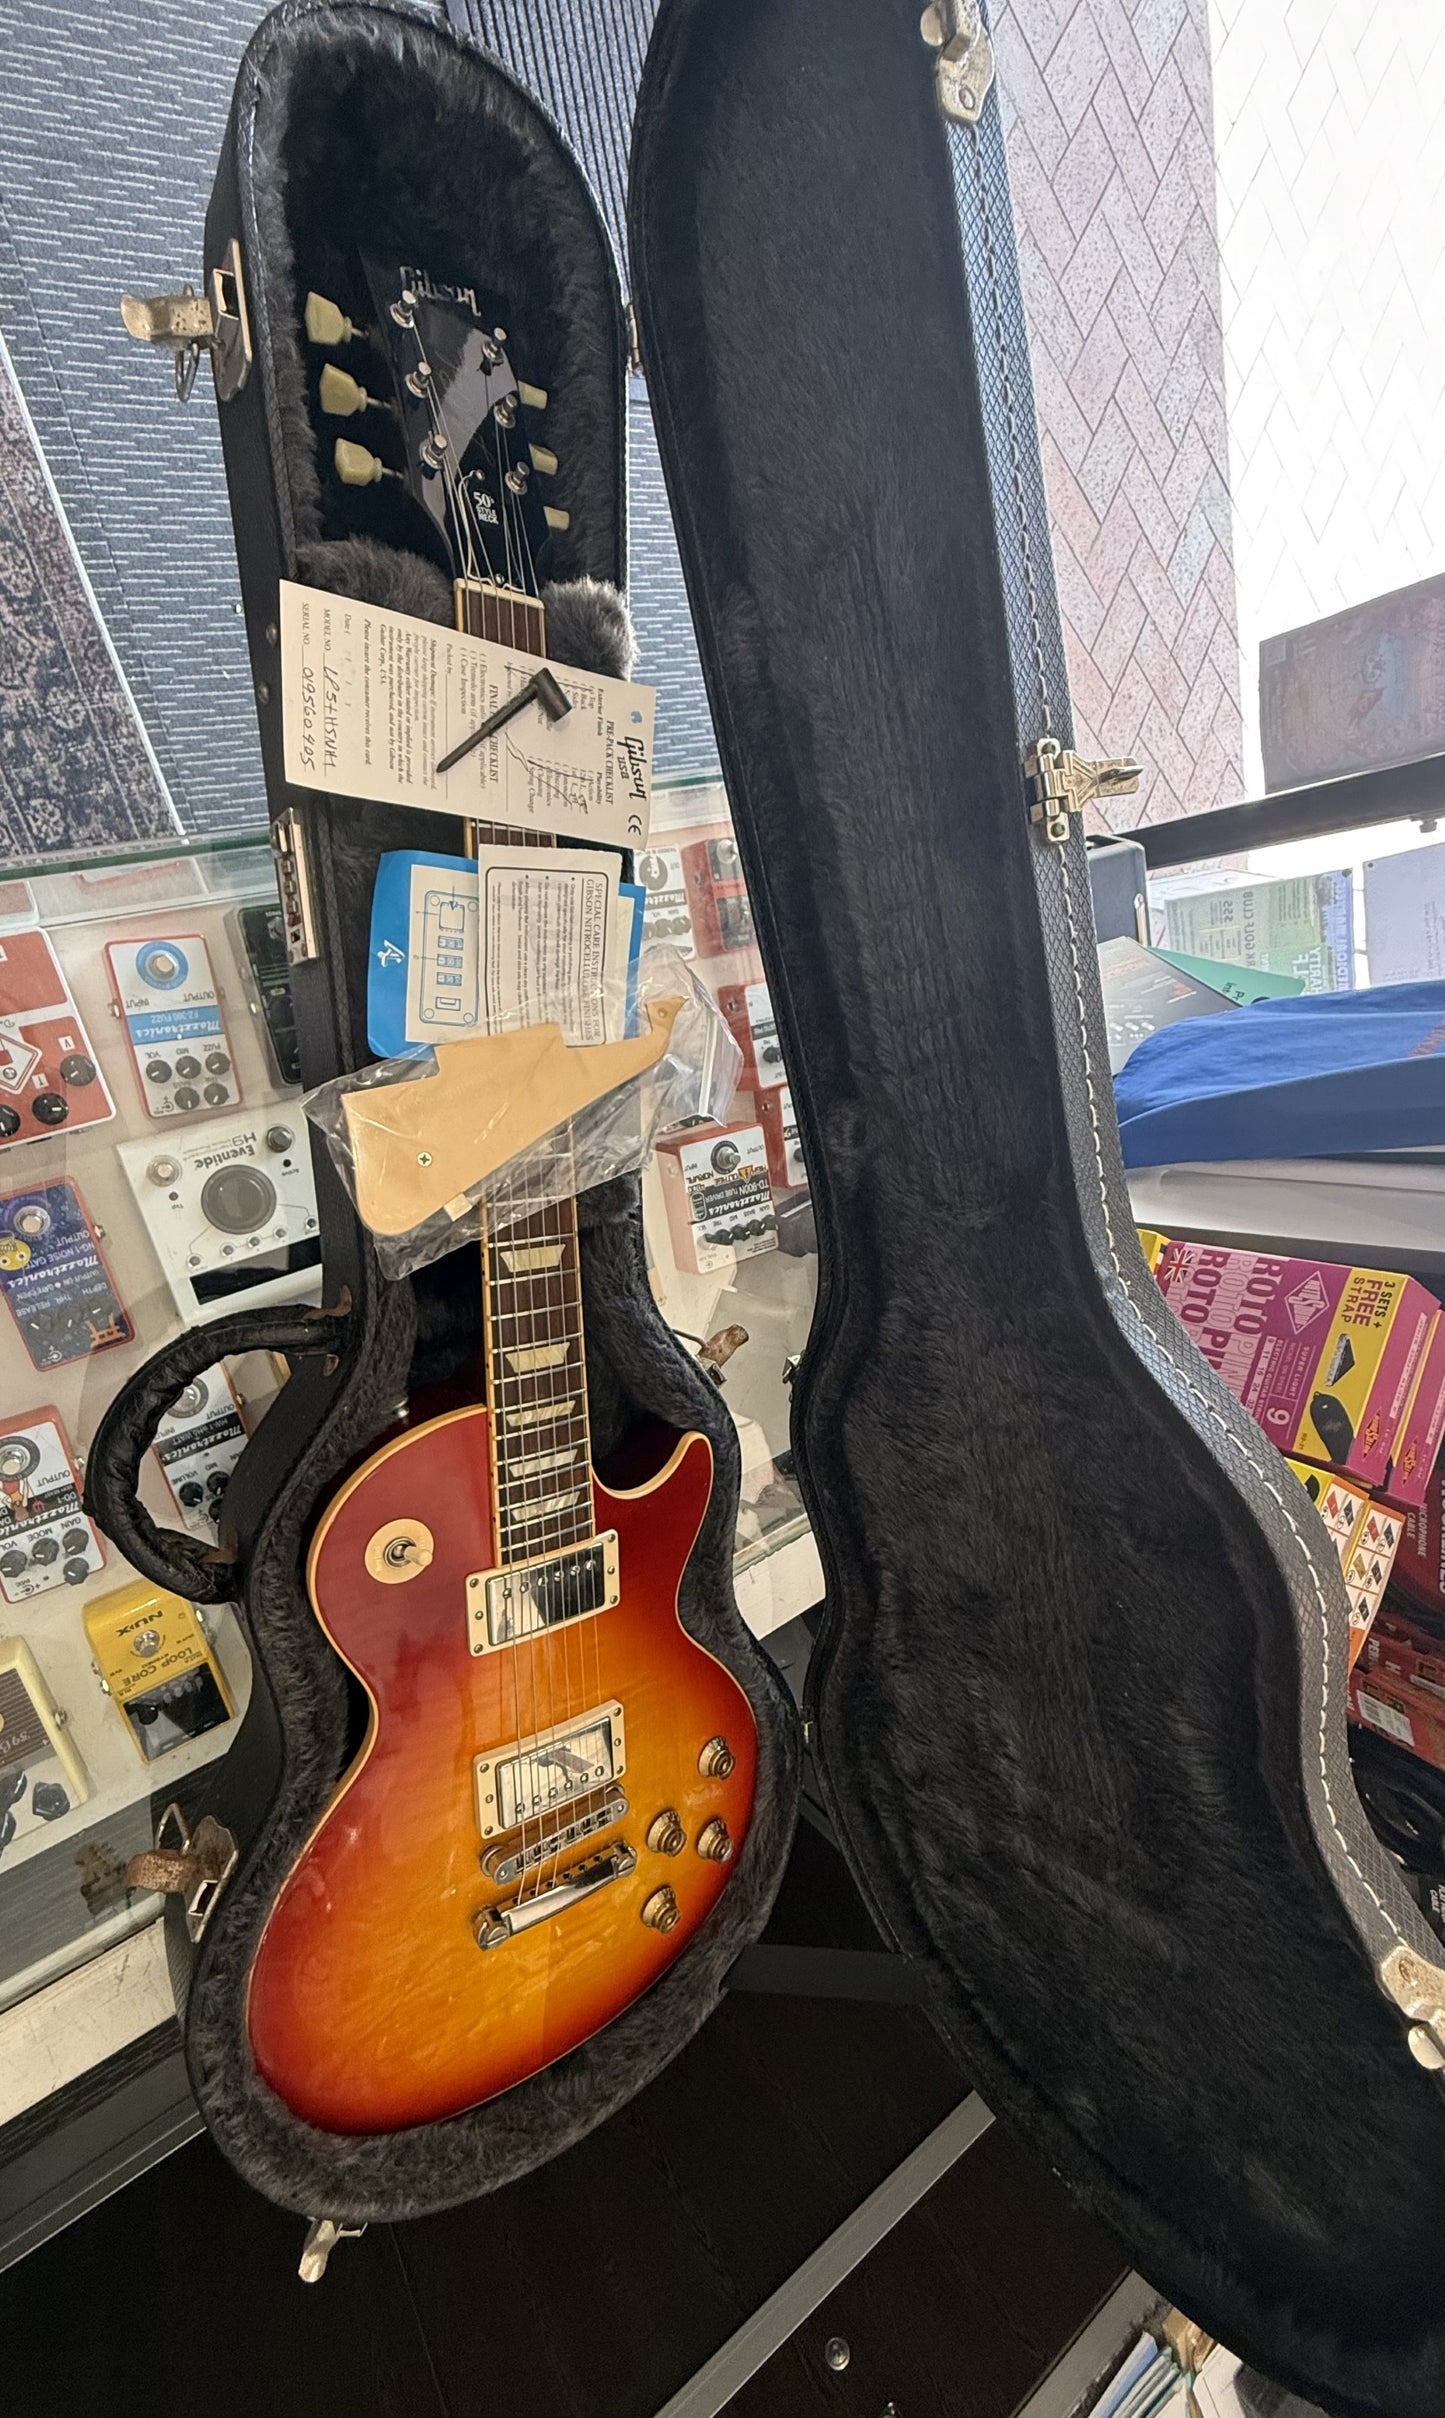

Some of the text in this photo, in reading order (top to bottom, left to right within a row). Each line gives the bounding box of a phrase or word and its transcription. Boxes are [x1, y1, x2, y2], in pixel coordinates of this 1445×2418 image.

[323, 608, 331, 635] MODEL
[459, 658, 468, 714] Case Inspection
[489, 684, 498, 782] FINAL CHECKLIST
[605, 720, 614, 804] PRE-PACK CHECKLIST
[616, 736, 647, 800] Gibson
[627, 814, 641, 835] CE
[585, 879, 593, 914] GIBSON
[593, 883, 602, 921] SPECIAL
[592, 924, 600, 948] CARE
[582, 917, 591, 998] NITROCELLULOSE
[124, 998, 148, 1008] INPUT
[182, 991, 214, 1001] OUTPUT
[145, 1050, 160, 1059] VOL
[175, 1046, 189, 1055] MID
[203, 1042, 220, 1051] FUZZ
[231, 1132, 256, 1147] H9
[193, 1144, 254, 1170] Eventide
[683, 1163, 697, 1171] INPUT
[704, 1191, 724, 1203] DRIVER
[54, 1229, 89, 1246] OUTPUT
[46, 1247, 73, 1262] NOISE
[81, 1281, 106, 1295] DEPTH
[1180, 1250, 1230, 1321] ROTO
[1207, 1255, 1257, 1327] ROTO
[1234, 1258, 1279, 1333] ROTO
[1341, 1277, 1364, 1322] STRAP
[1352, 1280, 1382, 1326] FREE
[15, 1300, 50, 1316] RELEASE
[1374, 1292, 1392, 1317] SETS
[1262, 1350, 1269, 1359] 11
[1260, 1339, 1282, 1397] ELECTRIC GUITAR
[1289, 1346, 1309, 1396] SUPER LIGHT
[1252, 1383, 1259, 1392] 24
[205, 1403, 234, 1419] OUTPUT
[1266, 1407, 1290, 1424] 9
[204, 1462, 217, 1470] MID
[36, 1469, 70, 1486] OUTPUT
[171, 1469, 198, 1485] VOLUME
[56, 1491, 76, 1504] DD-1
[60, 1516, 81, 1528] GAIN
[26, 1527, 52, 1541] MODE
[121, 1646, 192, 1686] LOOP CORE
